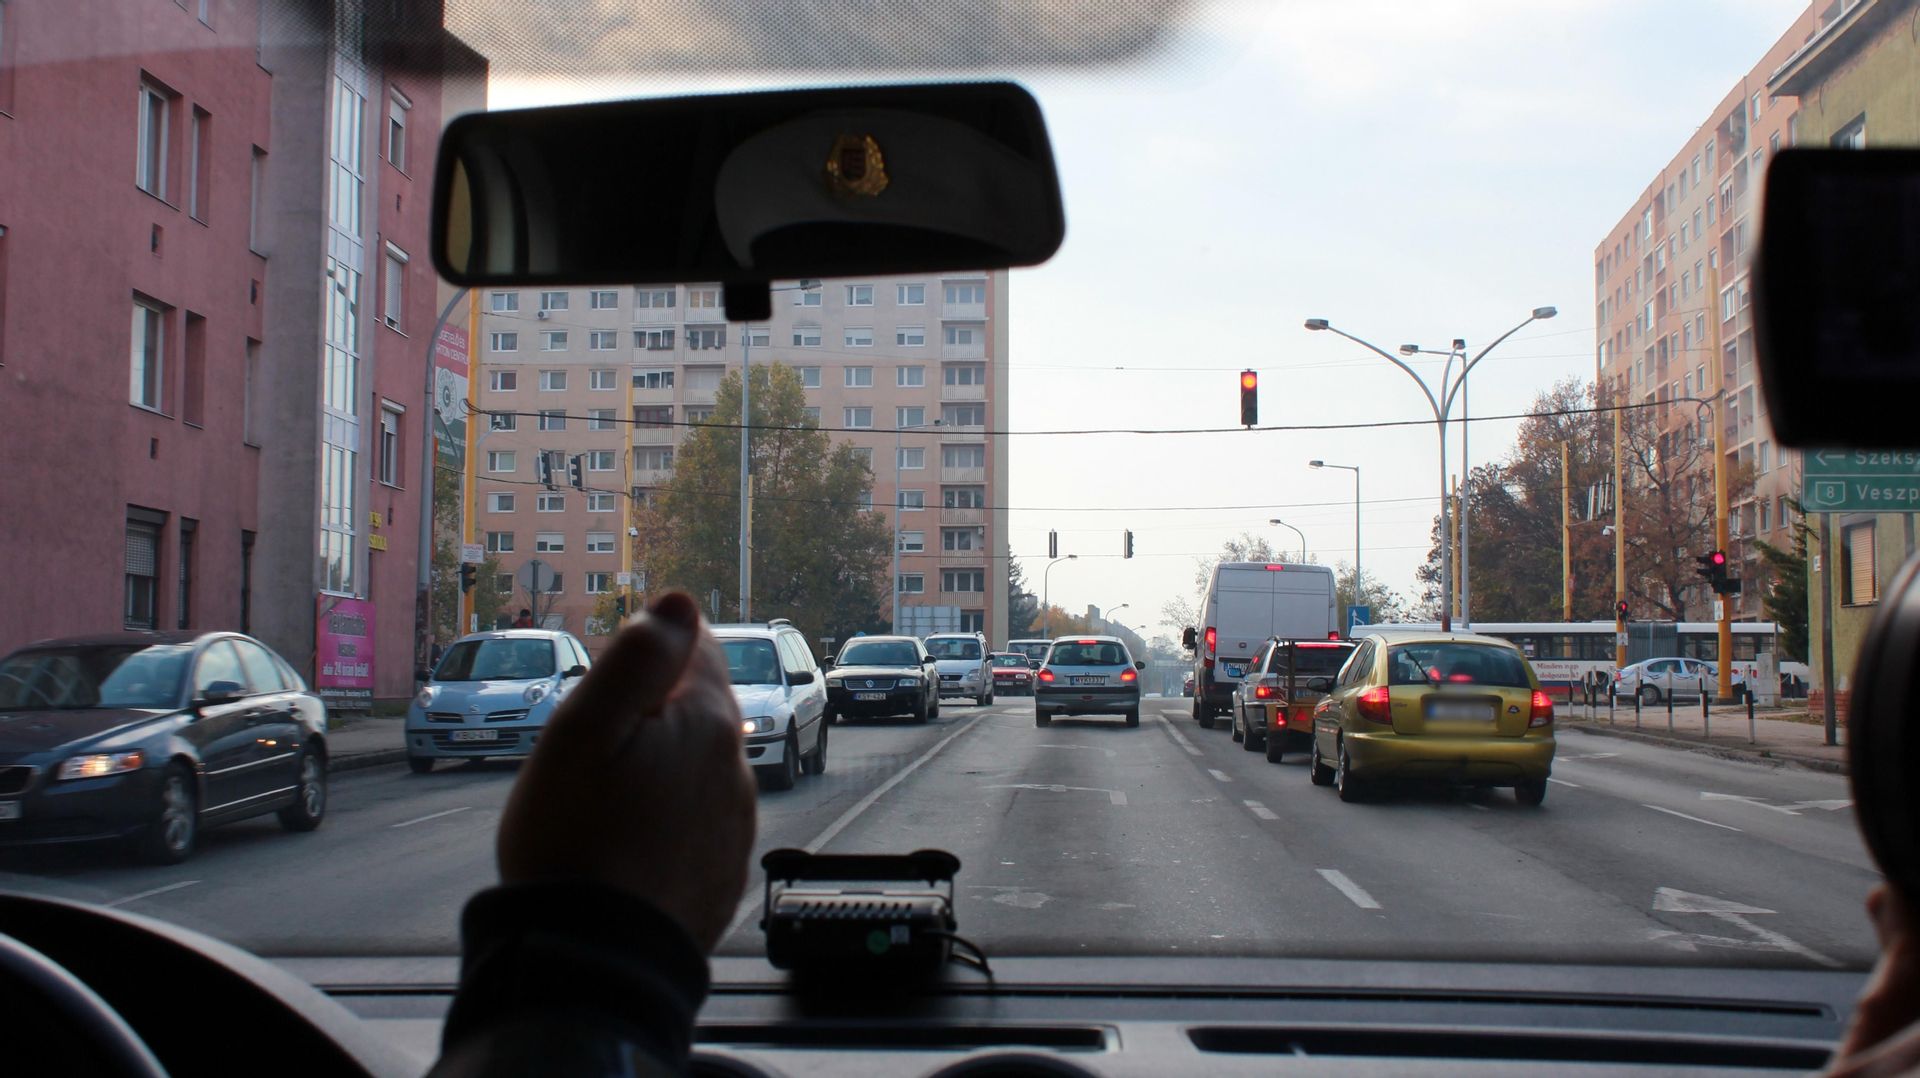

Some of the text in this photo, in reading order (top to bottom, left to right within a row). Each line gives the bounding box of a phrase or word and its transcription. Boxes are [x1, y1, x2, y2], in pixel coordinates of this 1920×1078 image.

[1855, 449, 1920, 465] Szeks
[1826, 484, 1920, 504] 8 Veszp
